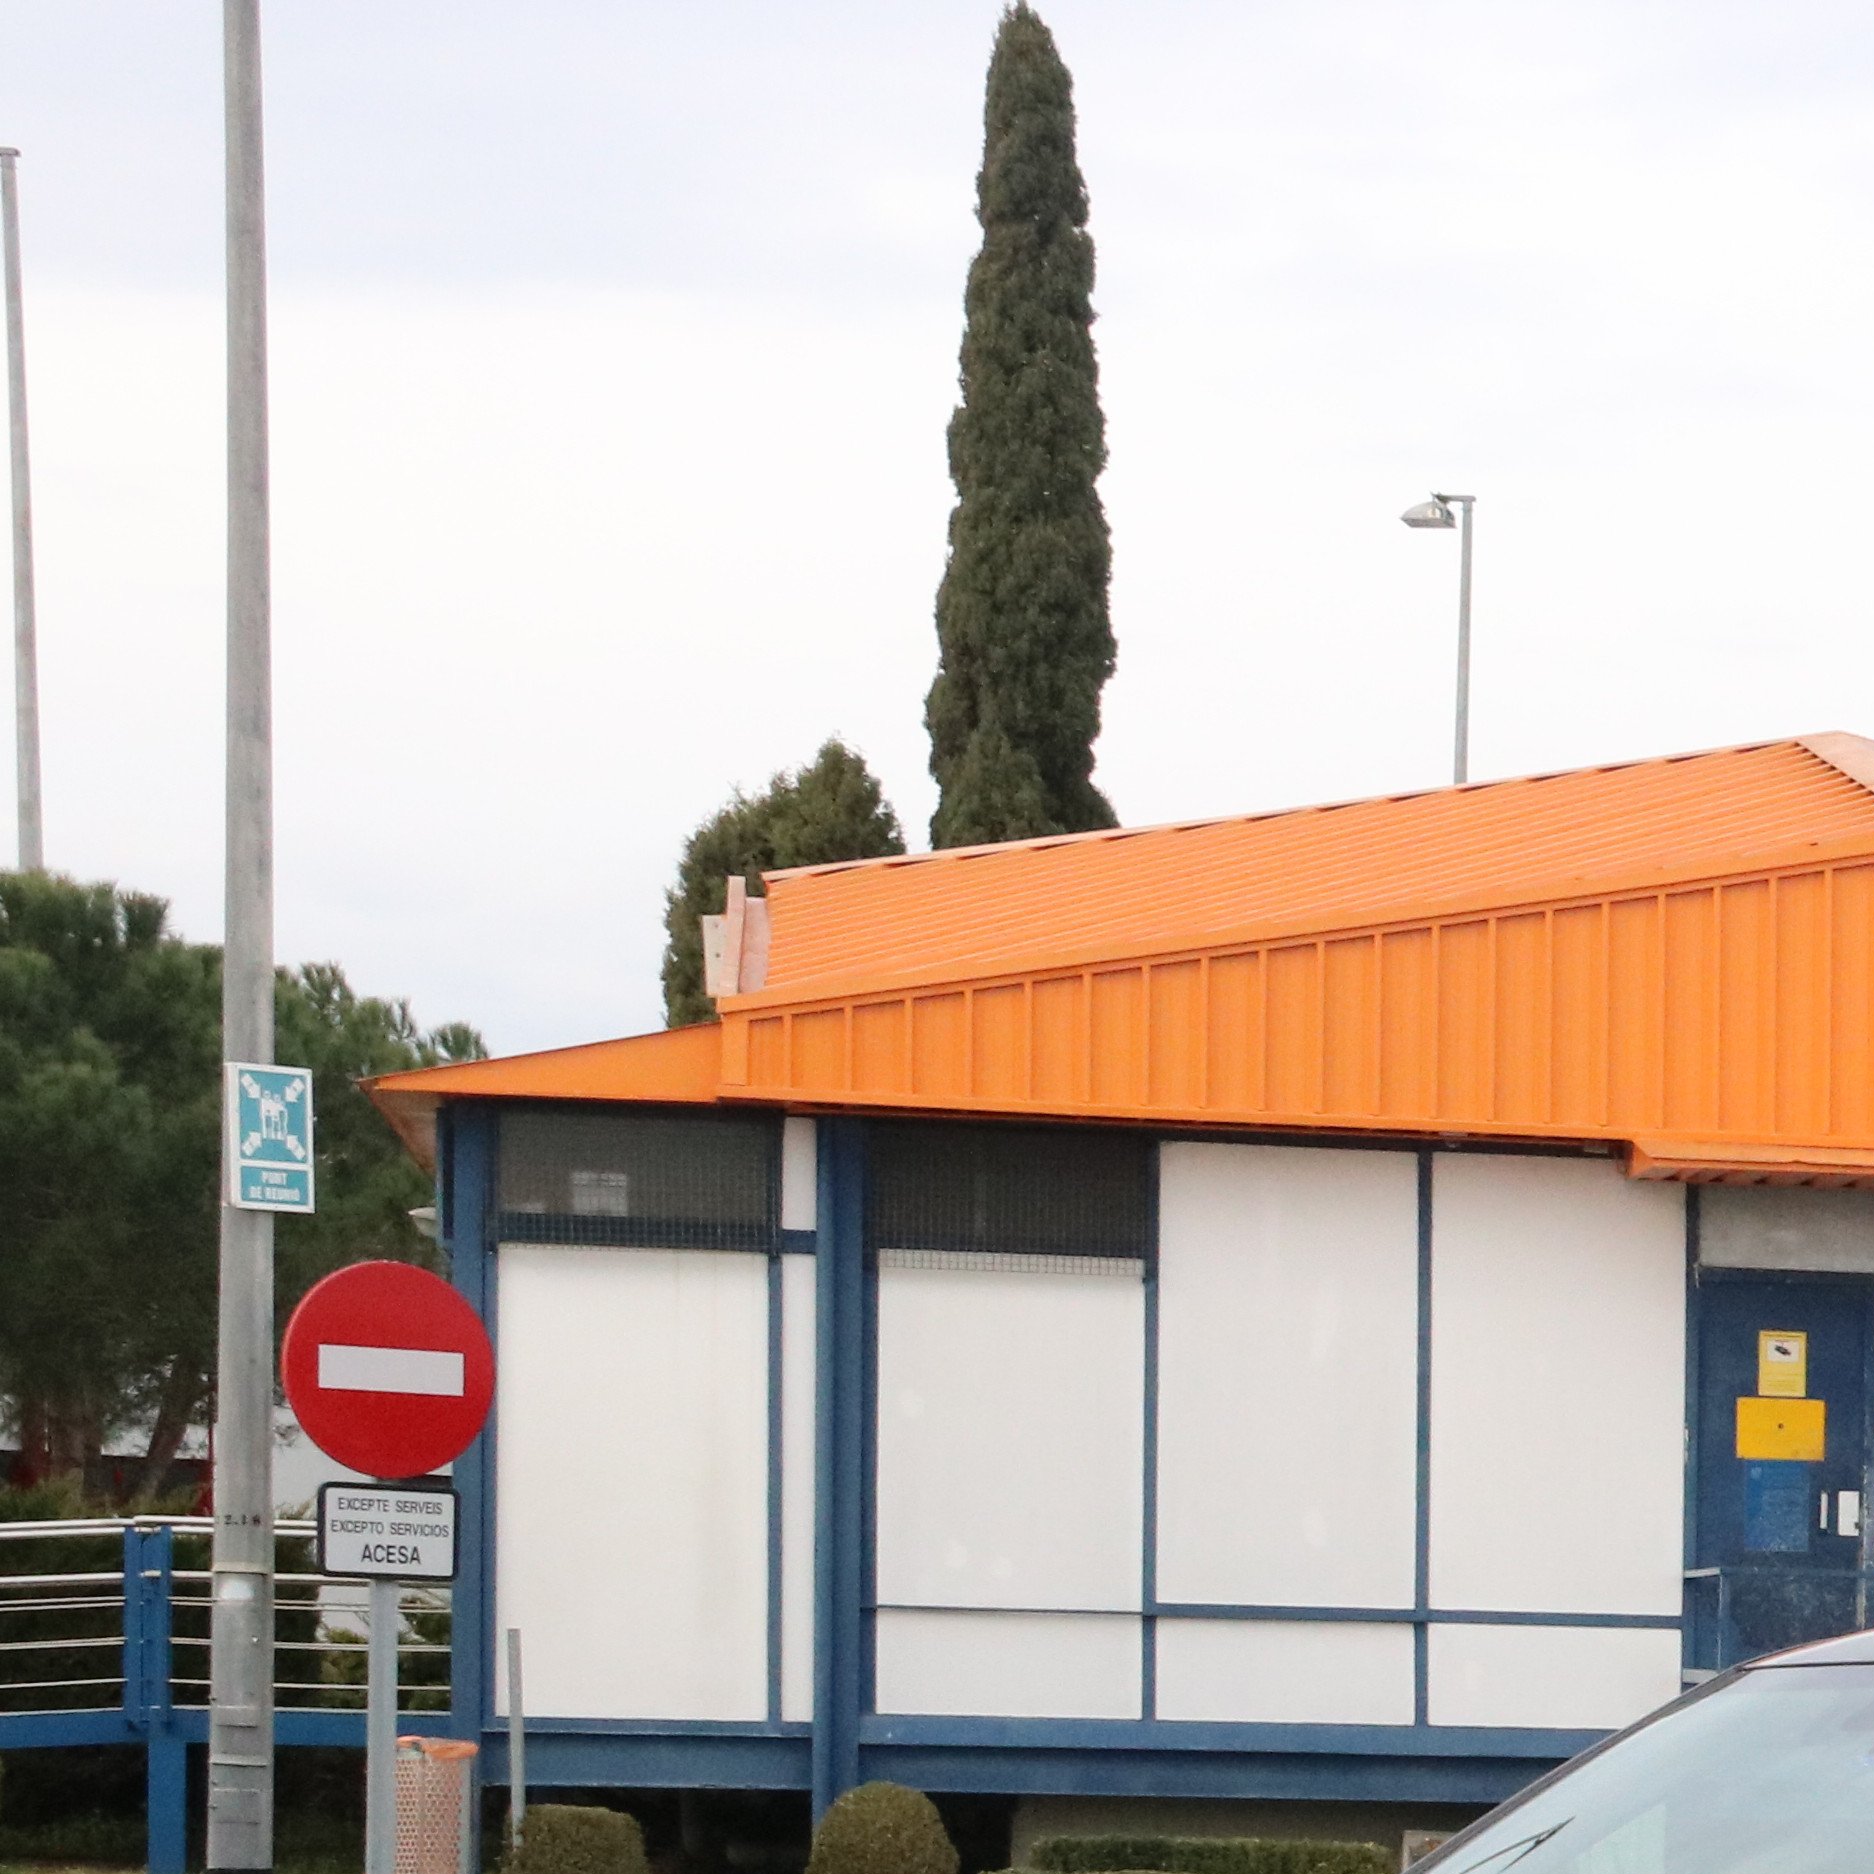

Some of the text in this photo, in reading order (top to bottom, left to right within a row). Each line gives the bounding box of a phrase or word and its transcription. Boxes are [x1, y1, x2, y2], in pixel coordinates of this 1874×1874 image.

[338, 1497, 443, 1515] EXCEPTE SERVEIS
[331, 1520, 450, 1538] EXCEPTO SERVICIOS
[361, 1544, 421, 1565] ACESA
